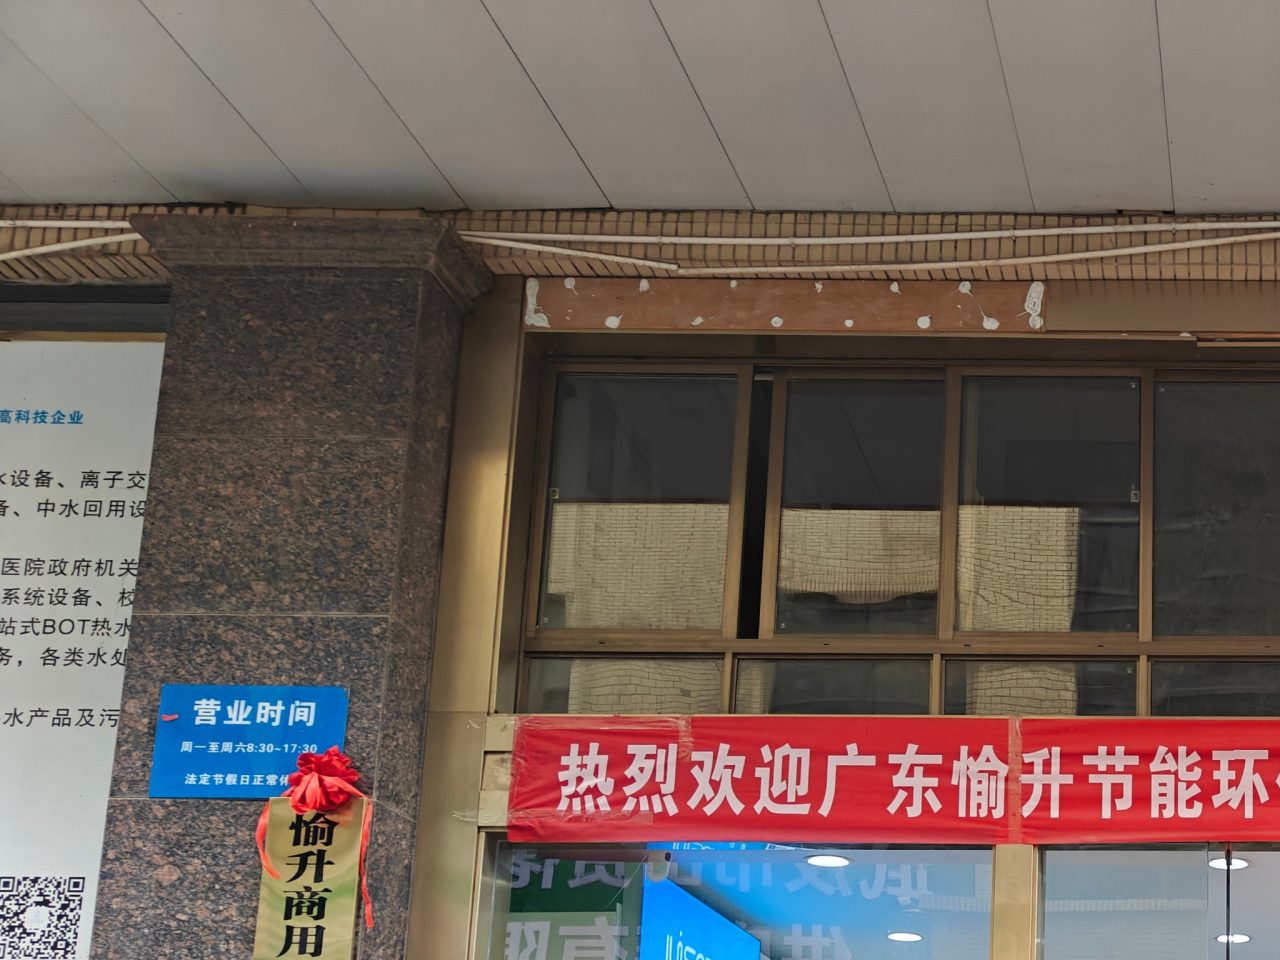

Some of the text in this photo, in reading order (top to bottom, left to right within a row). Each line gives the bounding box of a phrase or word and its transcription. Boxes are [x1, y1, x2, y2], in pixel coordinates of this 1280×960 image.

[0, 409, 84, 425] 高科技企业
[1, 558, 138, 577] 医院政府机关
[193, 698, 317, 727] 营业时间
